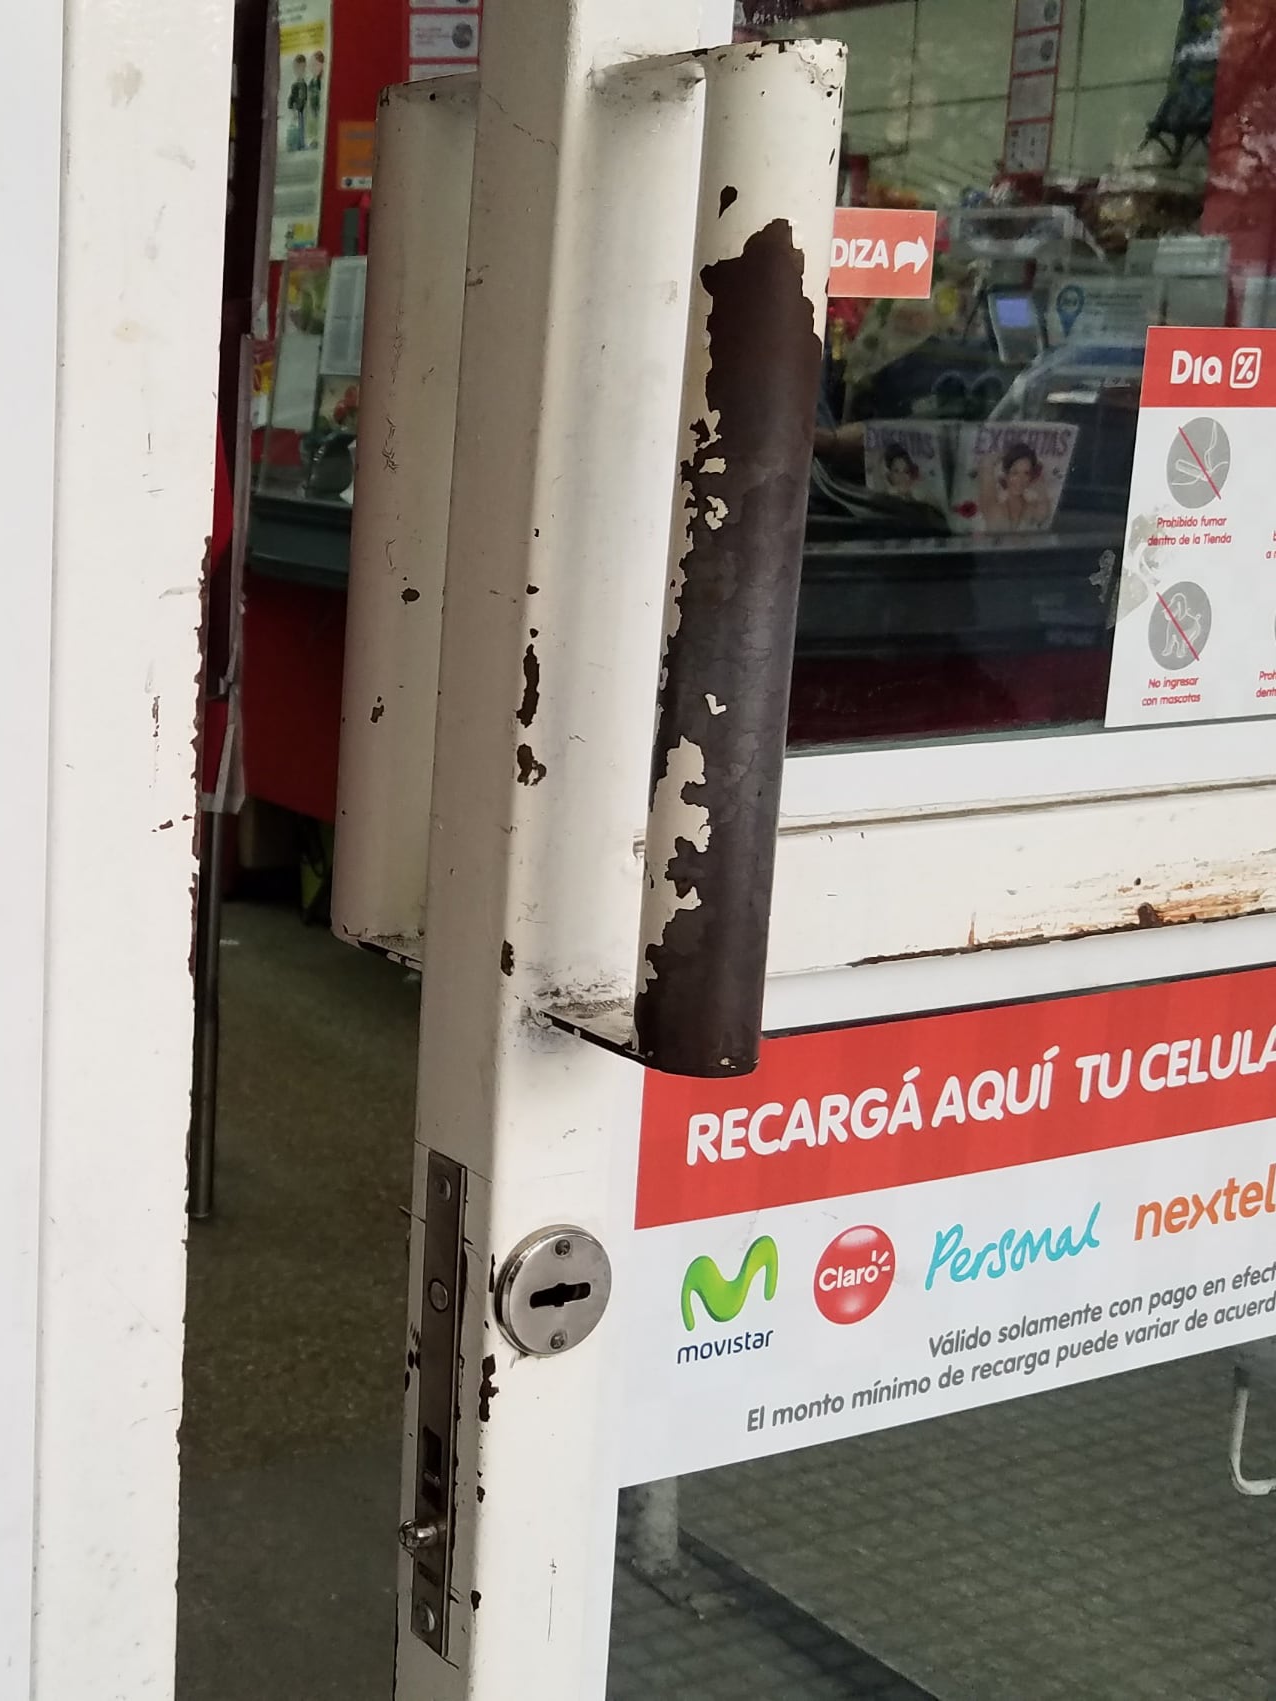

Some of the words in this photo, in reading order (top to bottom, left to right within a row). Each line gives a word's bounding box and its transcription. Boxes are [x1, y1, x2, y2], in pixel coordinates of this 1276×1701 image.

[1147, 535, 1176, 547] dentro
[1179, 535, 1190, 546] de
[1192, 535, 1201, 545] la
[1203, 533, 1232, 545] Tienda
[1157, 516, 1198, 529] Prohibido
[1200, 516, 1227, 528] fumar
[1142, 697, 1158, 707] con
[1160, 694, 1200, 705] mascotas
[1148, 678, 1161, 689] No
[1163, 677, 1199, 690] ingresar
[686, 1066, 923, 1166] RECARGÁ
[931, 1045, 1061, 1128] AQUÍ
[1075, 1049, 1132, 1103] TU
[1134, 1163, 1276, 1241] nextel
[924, 1201, 1101, 1291] Personal
[818, 1261, 879, 1293] Claro
[928, 1327, 992, 1359] Válido
[998, 1301, 1102, 1343] solamente
[1108, 1295, 1143, 1319] con
[1148, 1283, 1197, 1315] pago
[1203, 1277, 1226, 1297] en
[677, 1328, 774, 1365] movistar
[746, 1405, 766, 1433] El
[772, 1391, 845, 1428] monto
[851, 1373, 931, 1407] mínimo
[938, 1364, 965, 1391] de
[971, 1346, 1051, 1382] recarga
[1055, 1332, 1119, 1370] puede
[1124, 1319, 1178, 1348] variar
[1185, 1309, 1209, 1333] de
